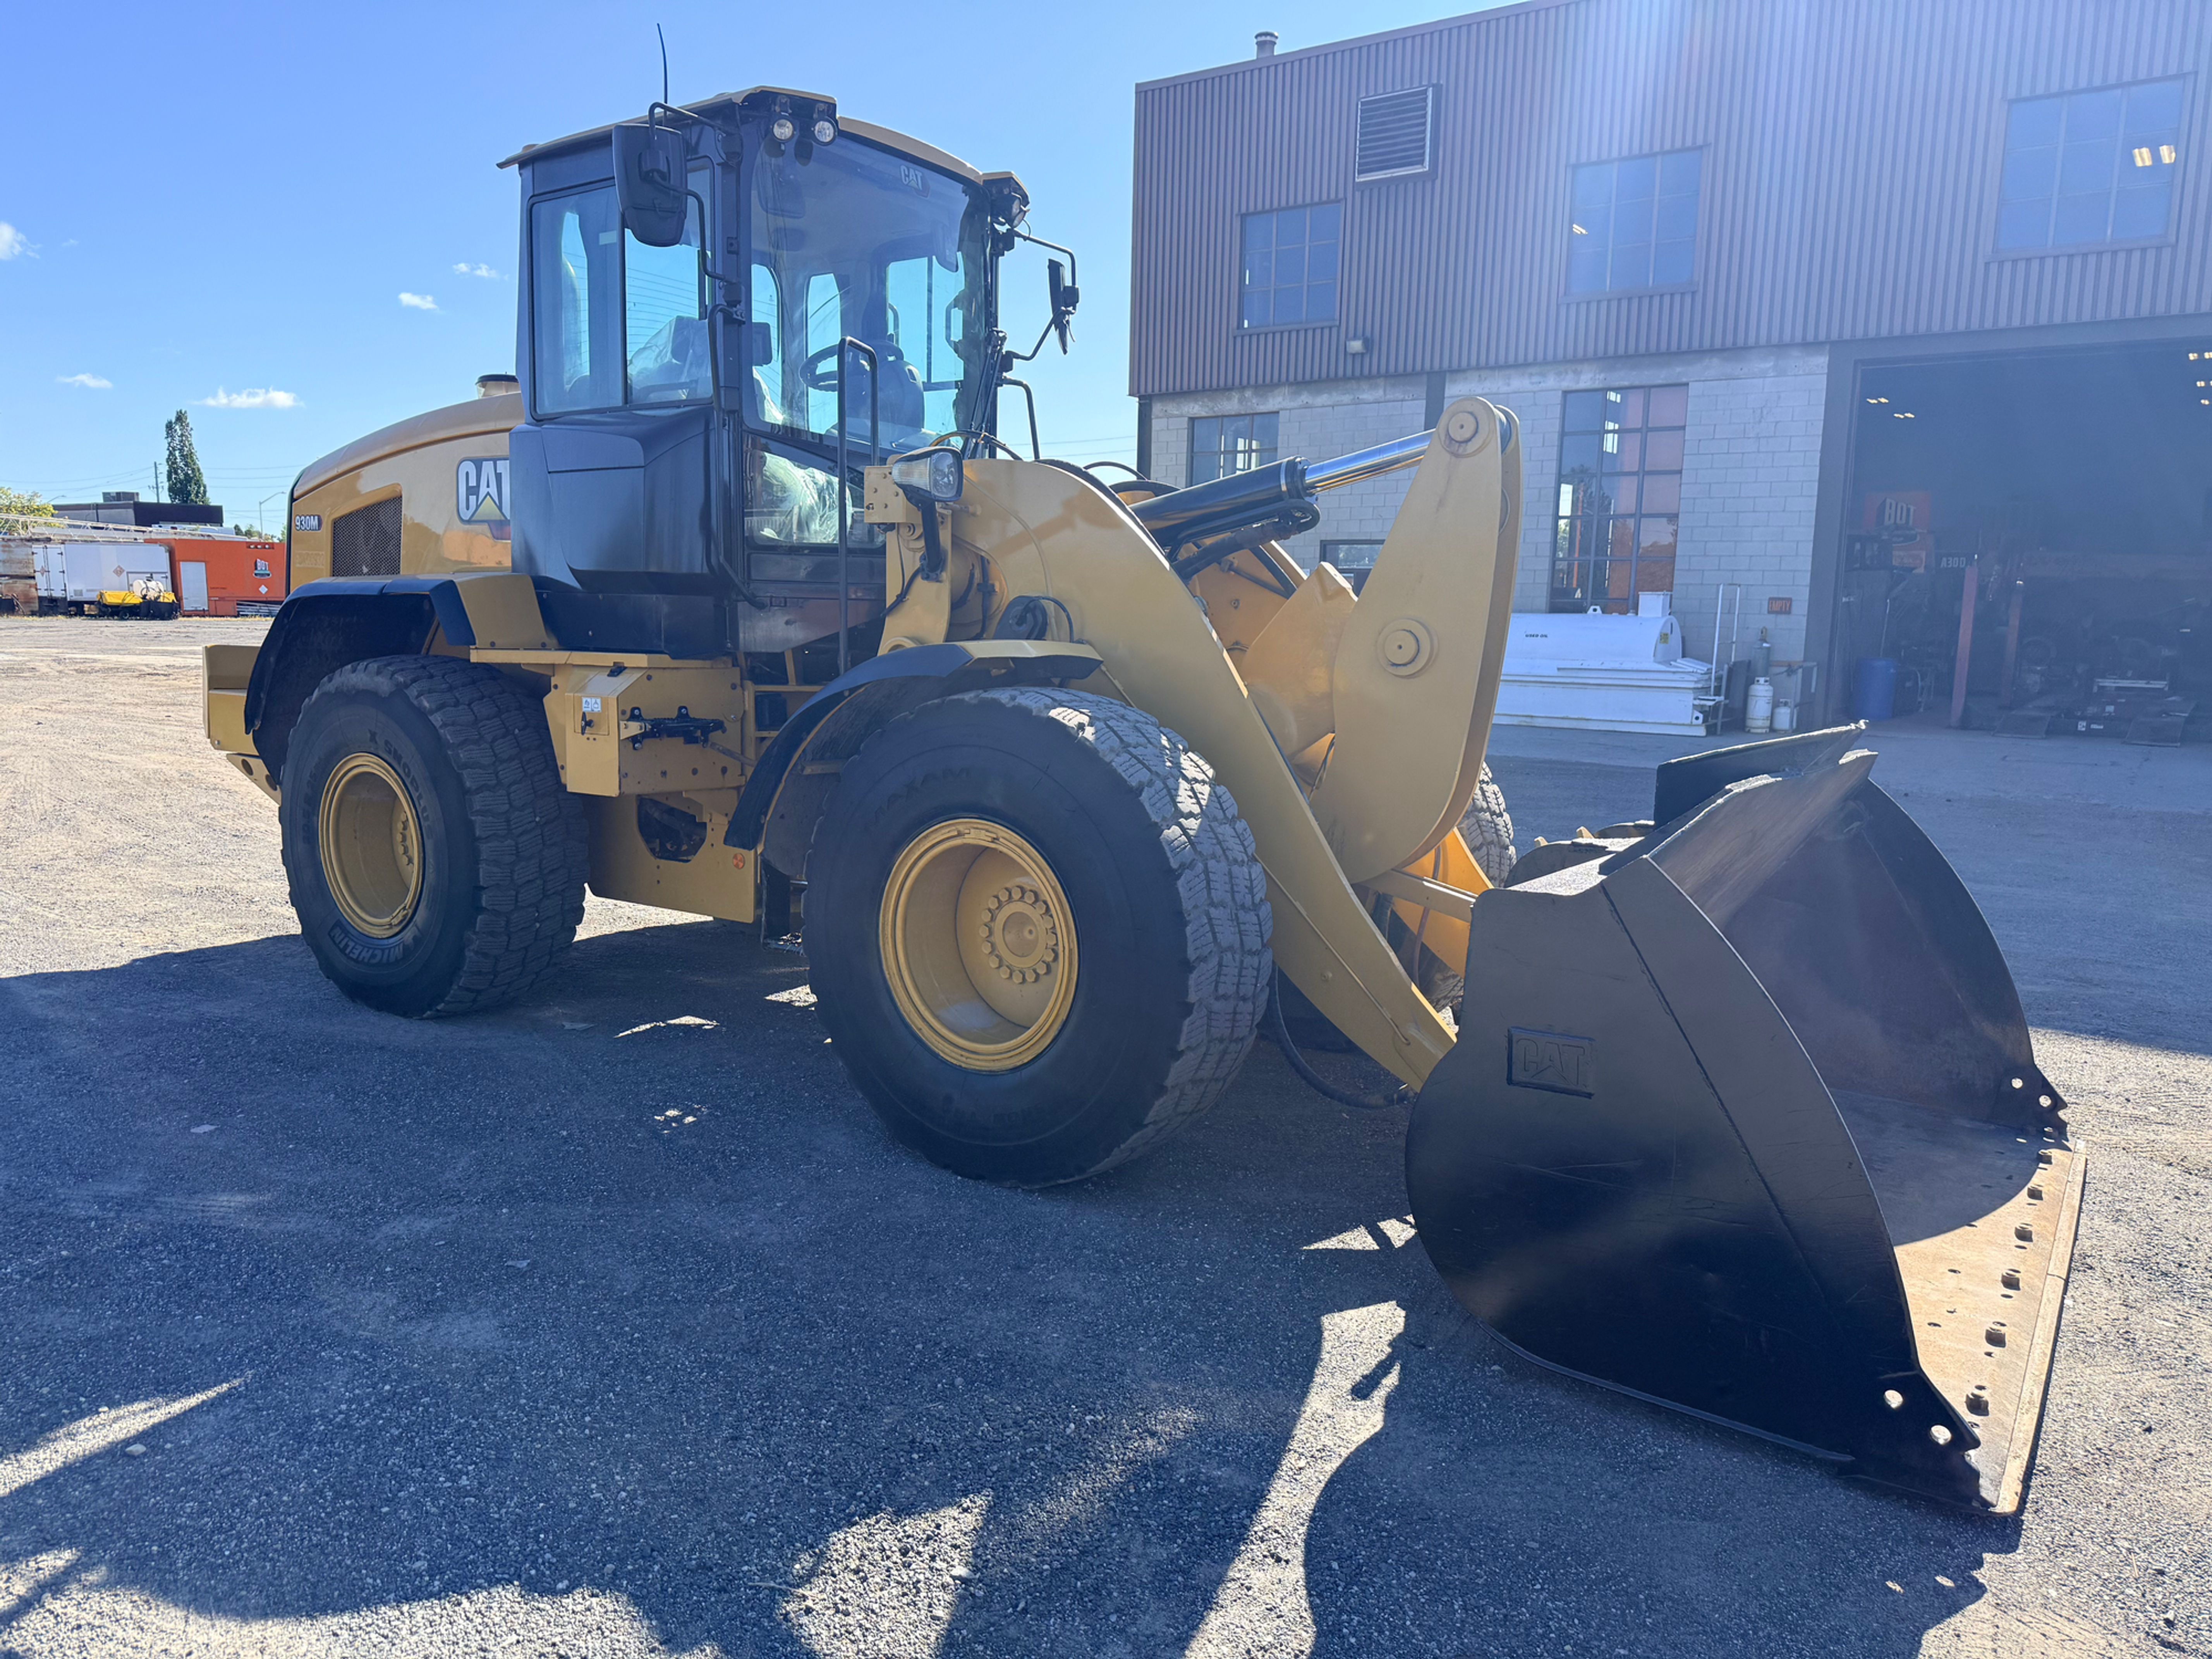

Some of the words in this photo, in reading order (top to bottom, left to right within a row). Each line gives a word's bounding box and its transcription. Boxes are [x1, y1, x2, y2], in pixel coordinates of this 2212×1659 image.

[900, 165, 922, 190] CAT
[458, 460, 510, 520] CAT
[295, 515, 318, 530] 930M
[1884, 498, 1917, 526] BOT
[1769, 600, 1791, 611] EMPTY
[368, 728, 378, 744] X
[384, 739, 433, 840] SNOPLUS
[329, 926, 404, 964] MICHELIN
[1515, 1037, 1586, 1086] CAT
